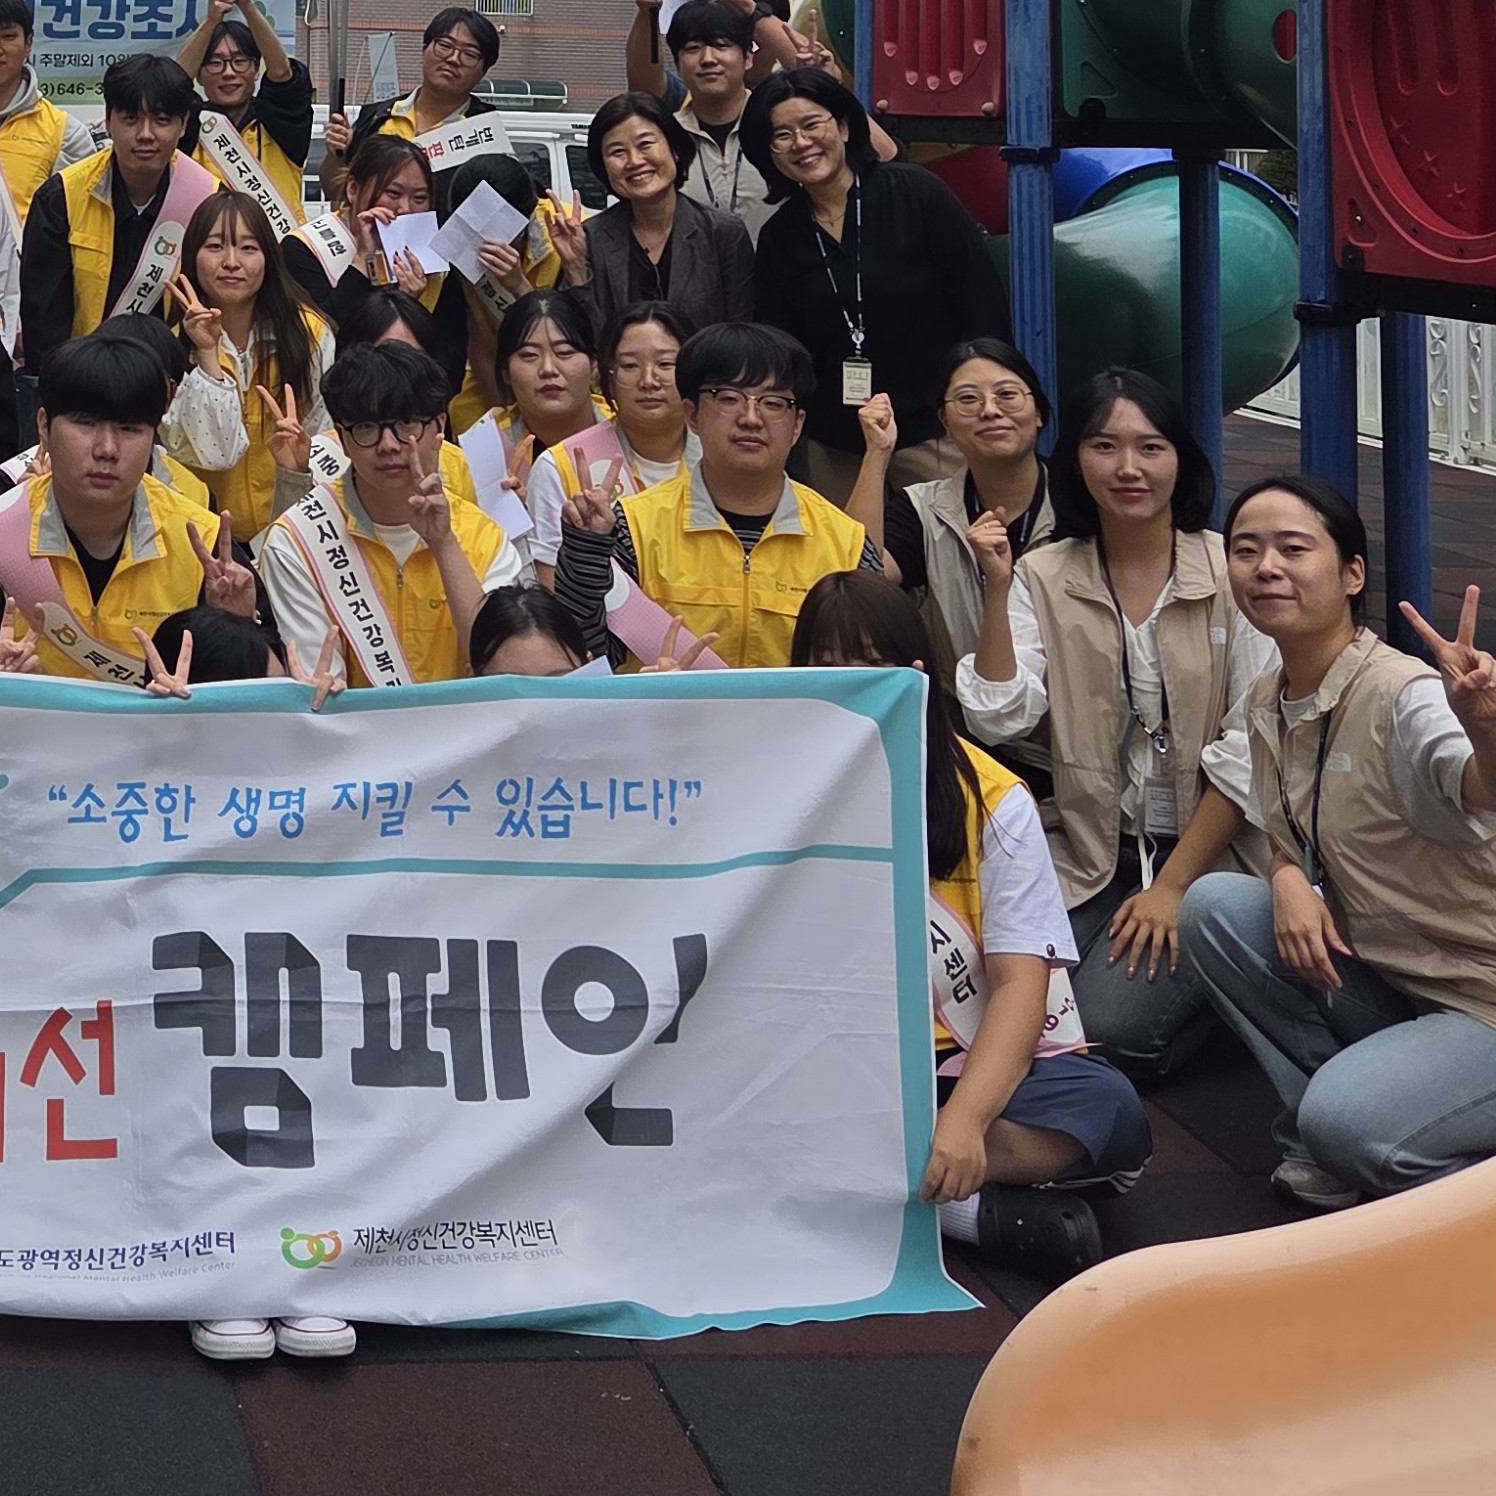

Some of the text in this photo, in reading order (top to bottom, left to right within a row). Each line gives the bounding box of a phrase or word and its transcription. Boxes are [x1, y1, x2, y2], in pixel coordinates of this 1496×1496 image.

[213, 133, 292, 236] 제천시정신건강
[217, 787, 306, 839] 생명
[331, 781, 413, 838] 지킬
[431, 778, 471, 826] 수
[152, 931, 708, 1169] 캠페인
[353, 1219, 558, 1255] 제천시정신건강복지센터
[431, 1253, 472, 1265] HEALTH
[474, 1251, 521, 1263] WELFARE
[158, 1265, 198, 1280] Welfare
[200, 1261, 237, 1272] Center
